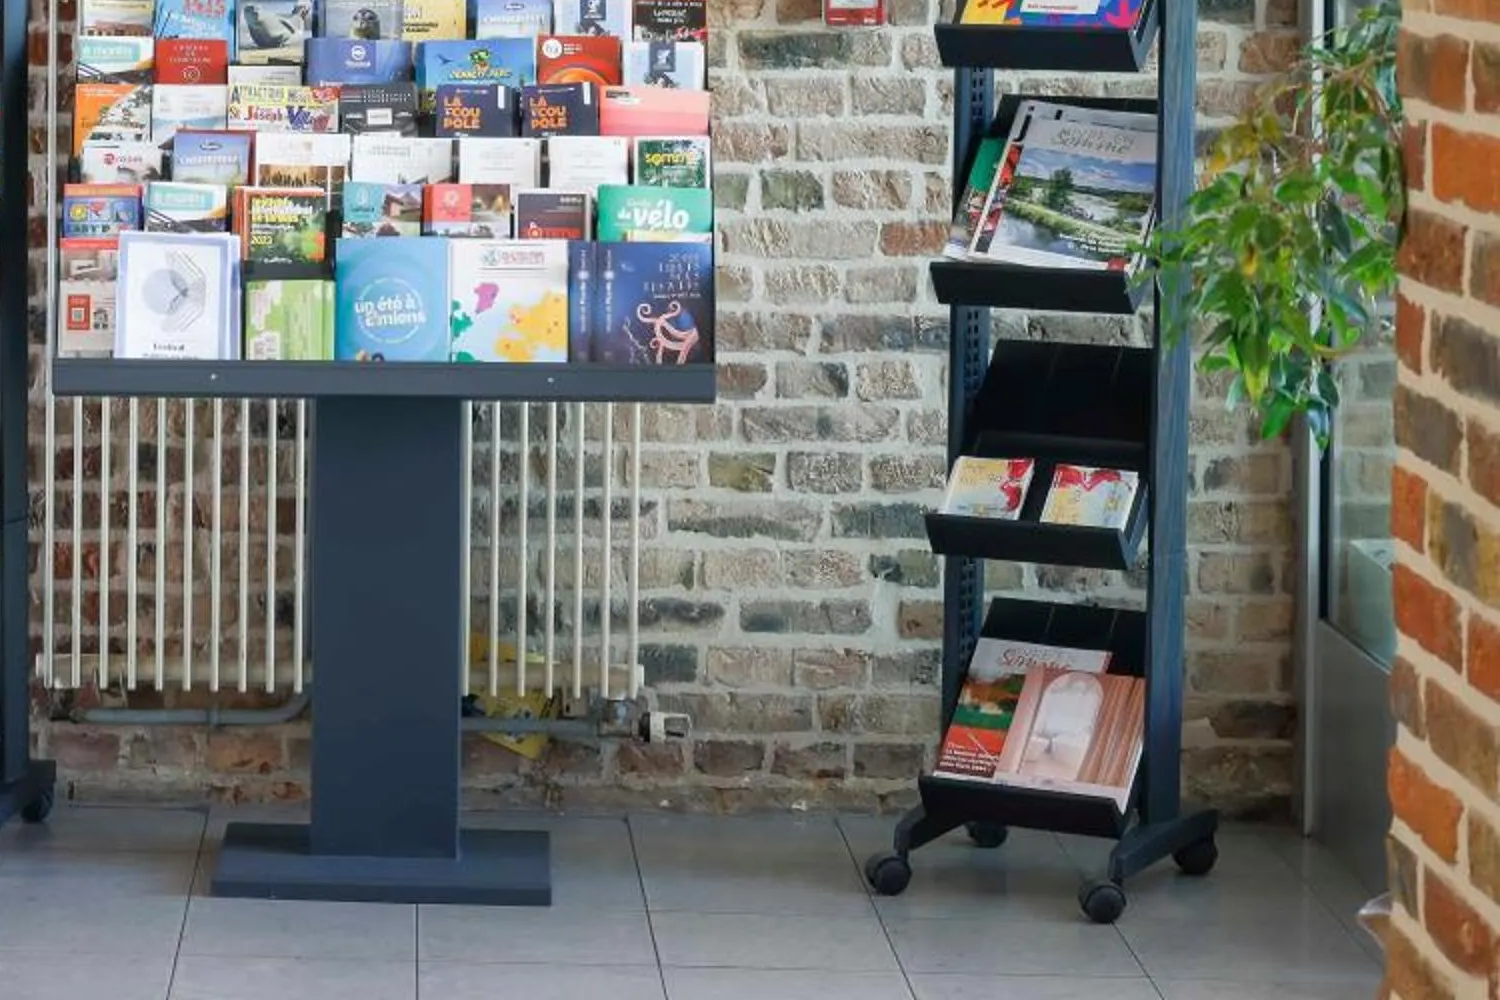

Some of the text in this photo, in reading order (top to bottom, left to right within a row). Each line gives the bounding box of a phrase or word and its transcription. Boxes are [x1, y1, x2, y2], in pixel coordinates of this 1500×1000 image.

[444, 96, 462, 106] LA
[530, 95, 549, 106] LA
[632, 199, 689, 230] vélo
